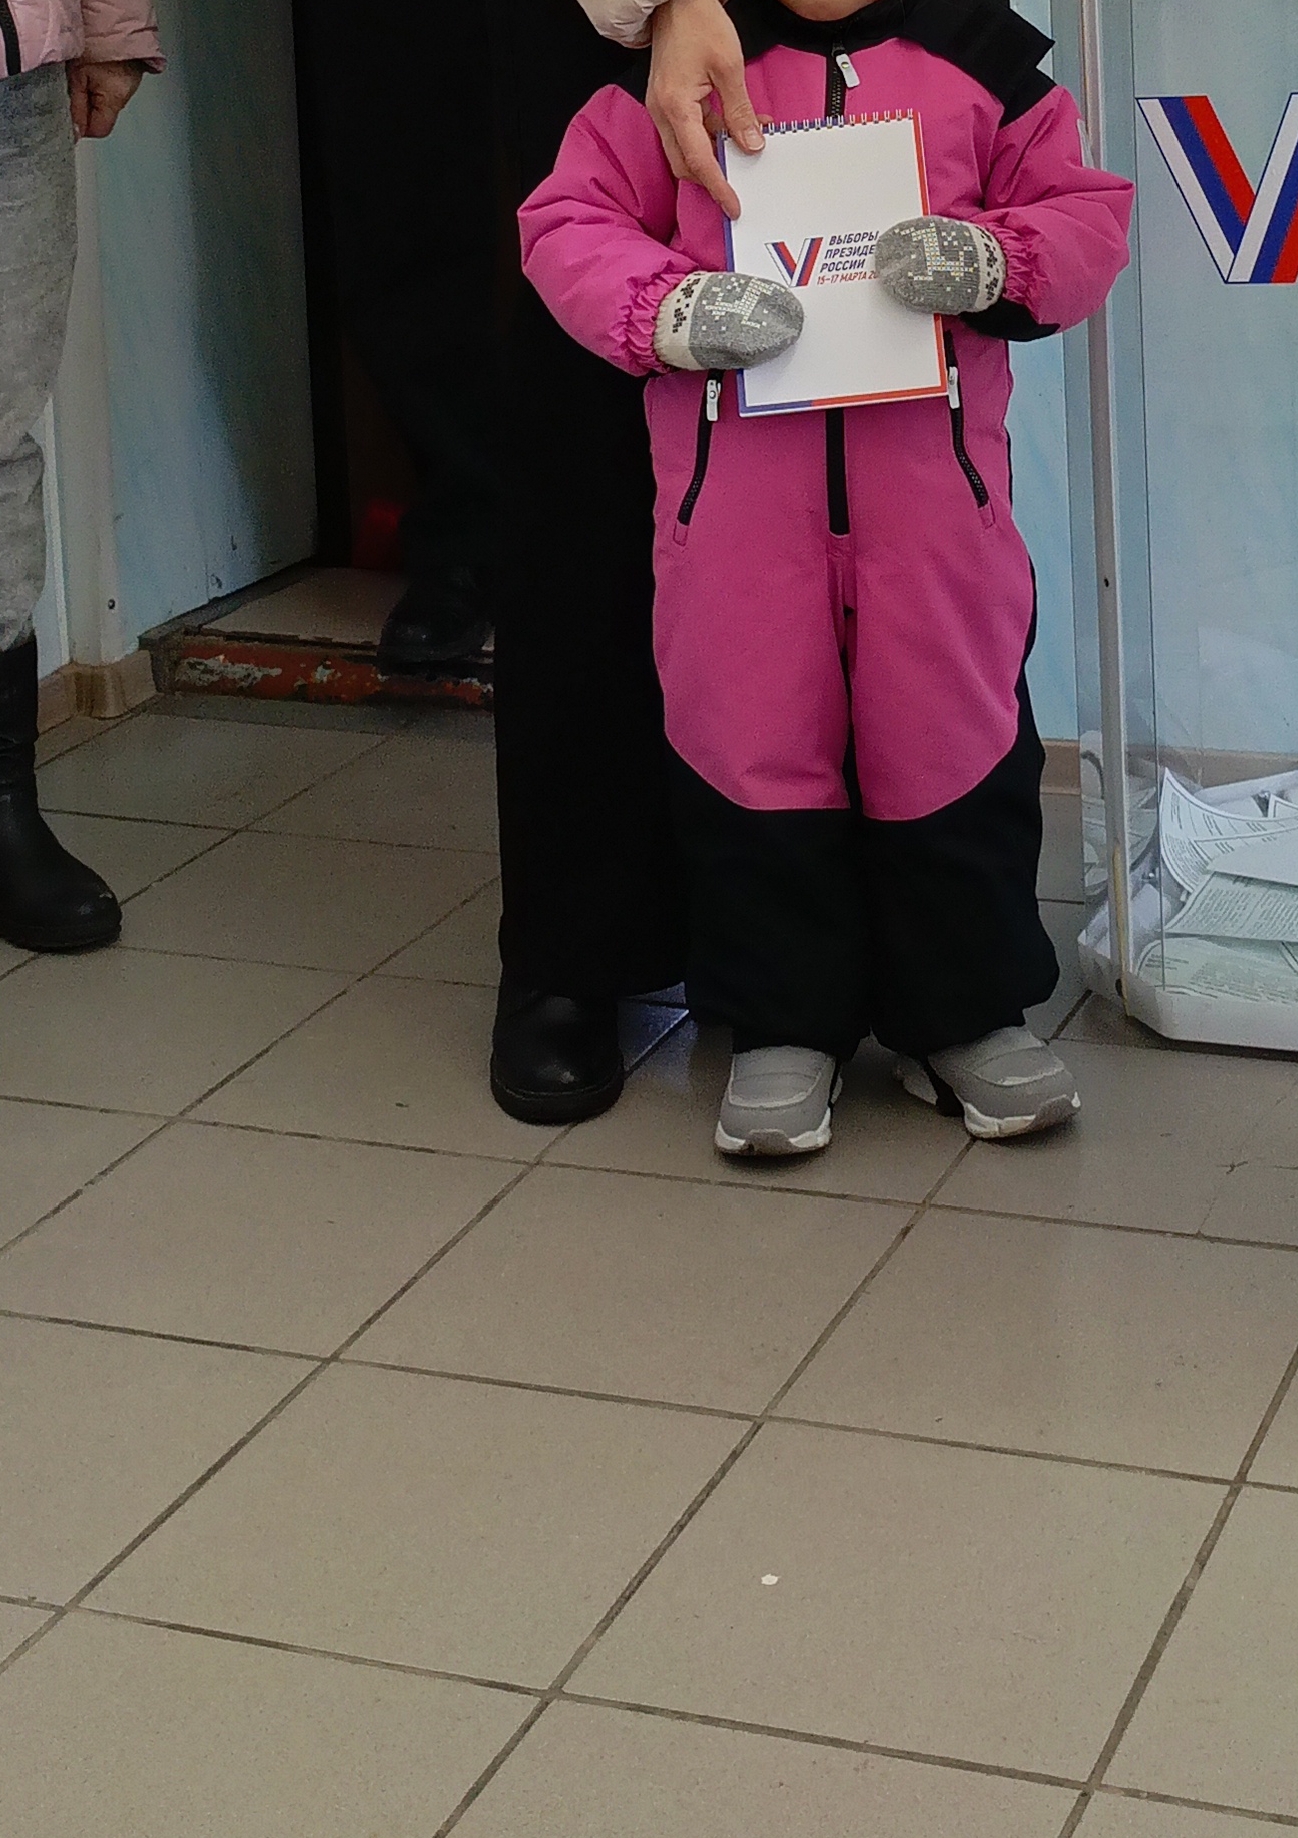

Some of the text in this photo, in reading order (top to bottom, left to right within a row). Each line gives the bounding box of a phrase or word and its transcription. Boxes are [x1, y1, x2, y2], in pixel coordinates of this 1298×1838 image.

[829, 231, 879, 246] ВЫБОРЫ
[820, 259, 866, 273] РОССИИ
[840, 272, 867, 282] МАРТА
